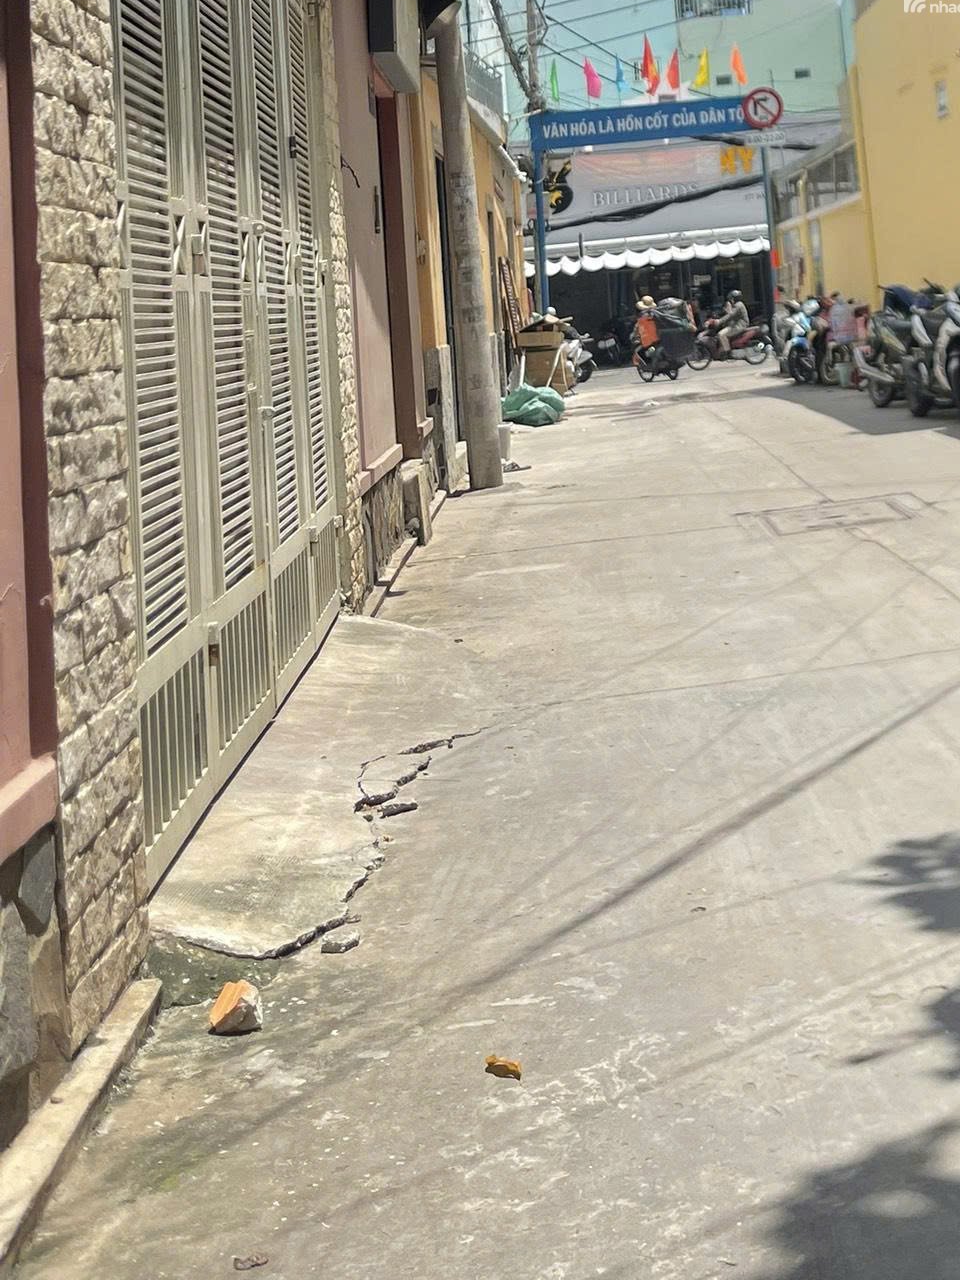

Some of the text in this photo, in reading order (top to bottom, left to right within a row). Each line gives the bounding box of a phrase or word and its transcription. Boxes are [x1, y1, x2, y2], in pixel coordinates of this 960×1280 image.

[543, 103, 745, 139] VĂN HÓA LÀ HỒN CỐT CỦA DÂN TỘ
